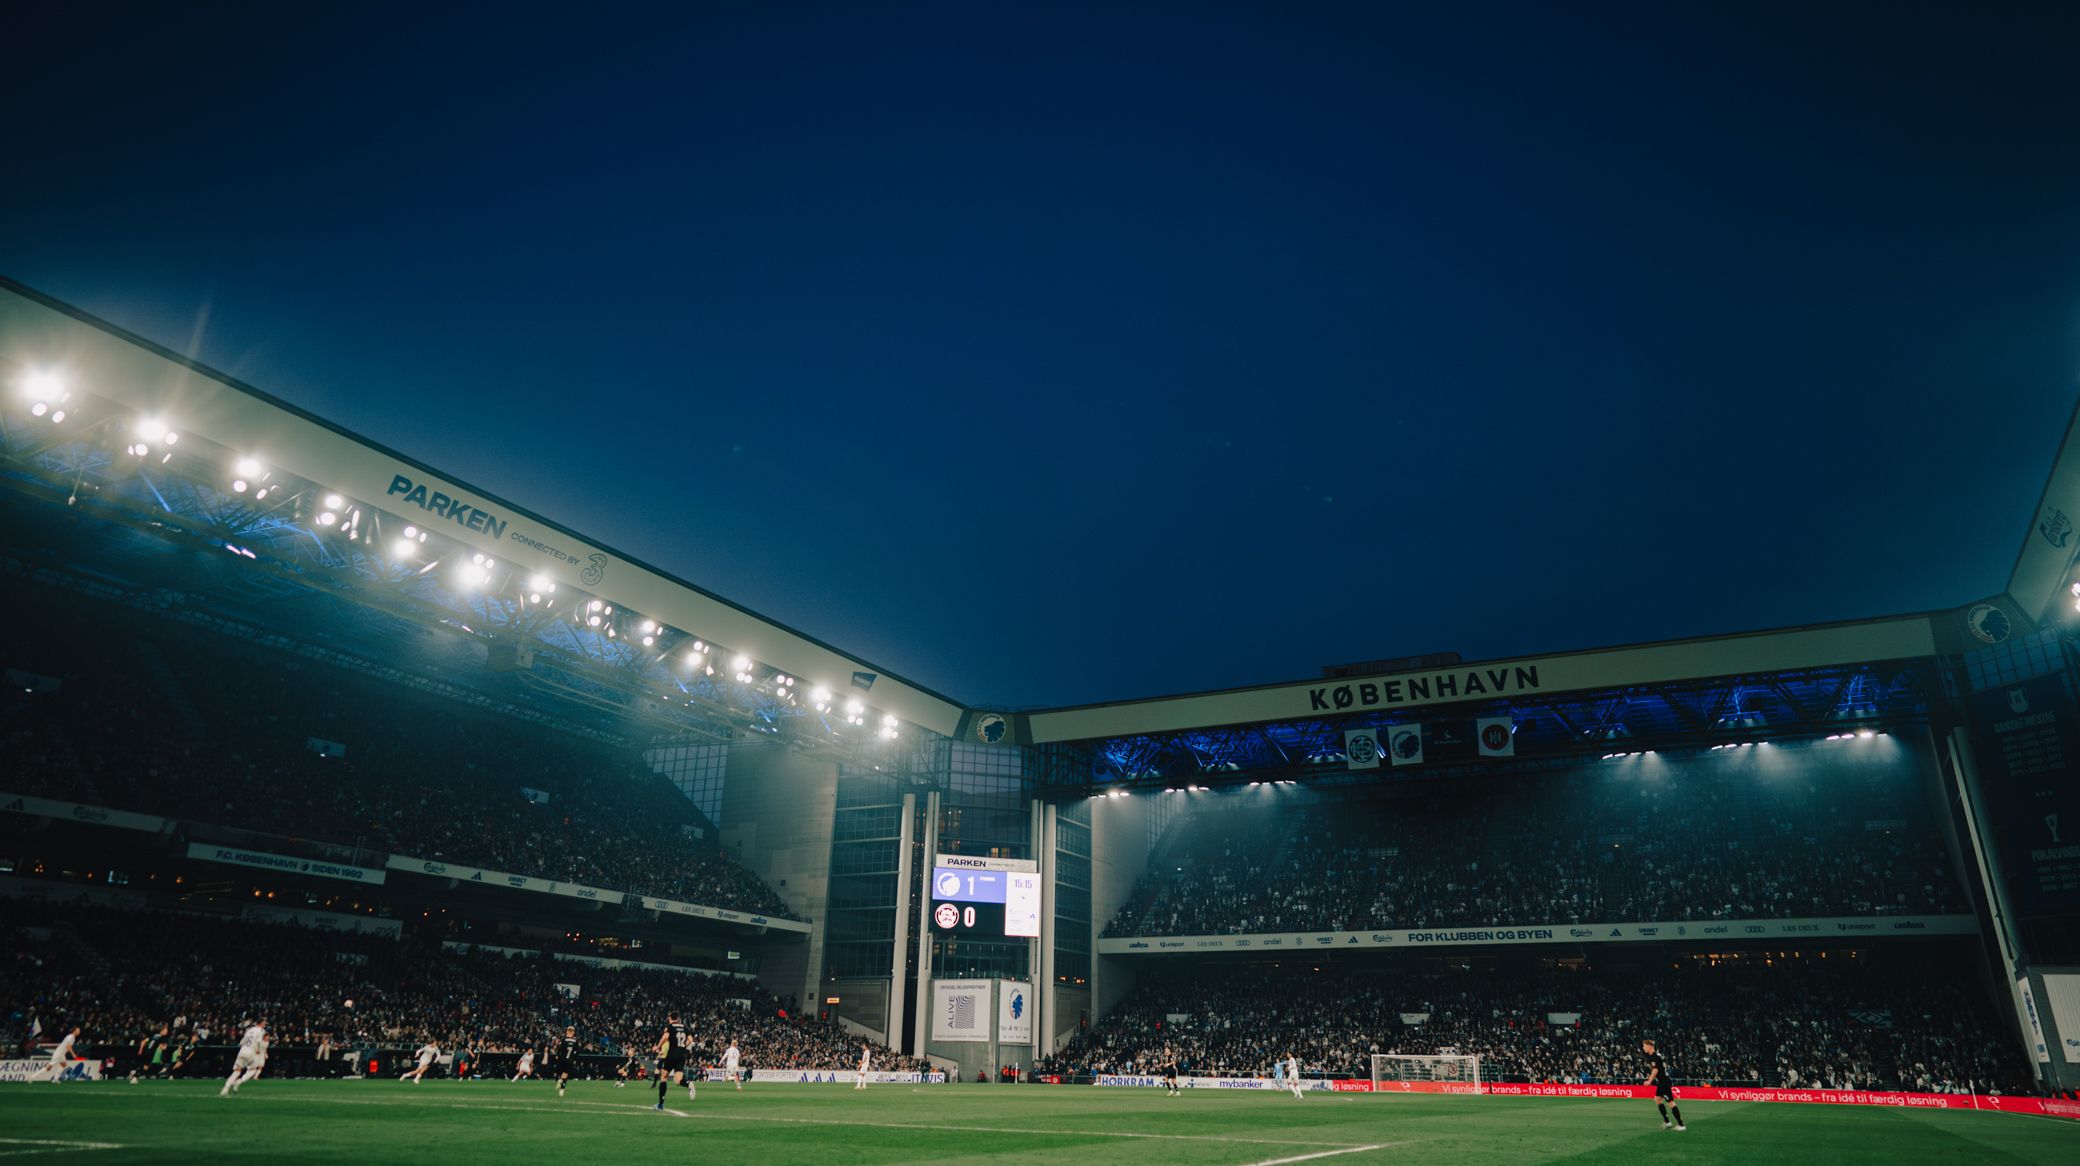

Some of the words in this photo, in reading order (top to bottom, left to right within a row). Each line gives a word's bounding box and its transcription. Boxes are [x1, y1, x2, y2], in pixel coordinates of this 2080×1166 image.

[387, 474, 507, 540] PARKEN
[511, 531, 567, 561] CONNECTED
[567, 555, 581, 566] BY
[1309, 666, 1540, 710] KØBENHAVN
[216, 850, 233, 860] F.C.
[235, 853, 298, 869] KØBENHAVN
[312, 864, 340, 875] SIDEN
[341, 869, 363, 879] 1992
[947, 858, 986, 867] PARKEN
[968, 876, 974, 896] 1
[1015, 880, 1032, 888] 15:15
[577, 889, 597, 898] andel
[964, 906, 975, 928] 0
[1408, 933, 1433, 942] FOR
[1436, 931, 1493, 941] KLUBBEN
[1496, 930, 1515, 940] OG
[1518, 929, 1553, 939] BYEN
[676, 1032, 686, 1047] 12
[566, 1046, 573, 1059] 7
[1102, 1077, 1154, 1087] HORKRAM
[1220, 1079, 1263, 1089] mybanker
[1341, 1083, 1369, 1092] løsning
[1492, 1085, 1521, 1094] brands
[1528, 1085, 1541, 1094] fra
[1543, 1086, 1556, 1094] idé
[1557, 1086, 1567, 1095] til
[1568, 1086, 1597, 1097] færdig
[1600, 1087, 1632, 1098] løsning
[1718, 1090, 1728, 1099] Vi
[1730, 1091, 1775, 1102] synliggør
[1778, 1092, 1812, 1101] brands
[1821, 1093, 1837, 1102] fra
[1839, 1093, 1855, 1102] idé
[1857, 1094, 1867, 1103] til
[1869, 1094, 1904, 1106] færdig
[1907, 1095, 1947, 1107] løsning
